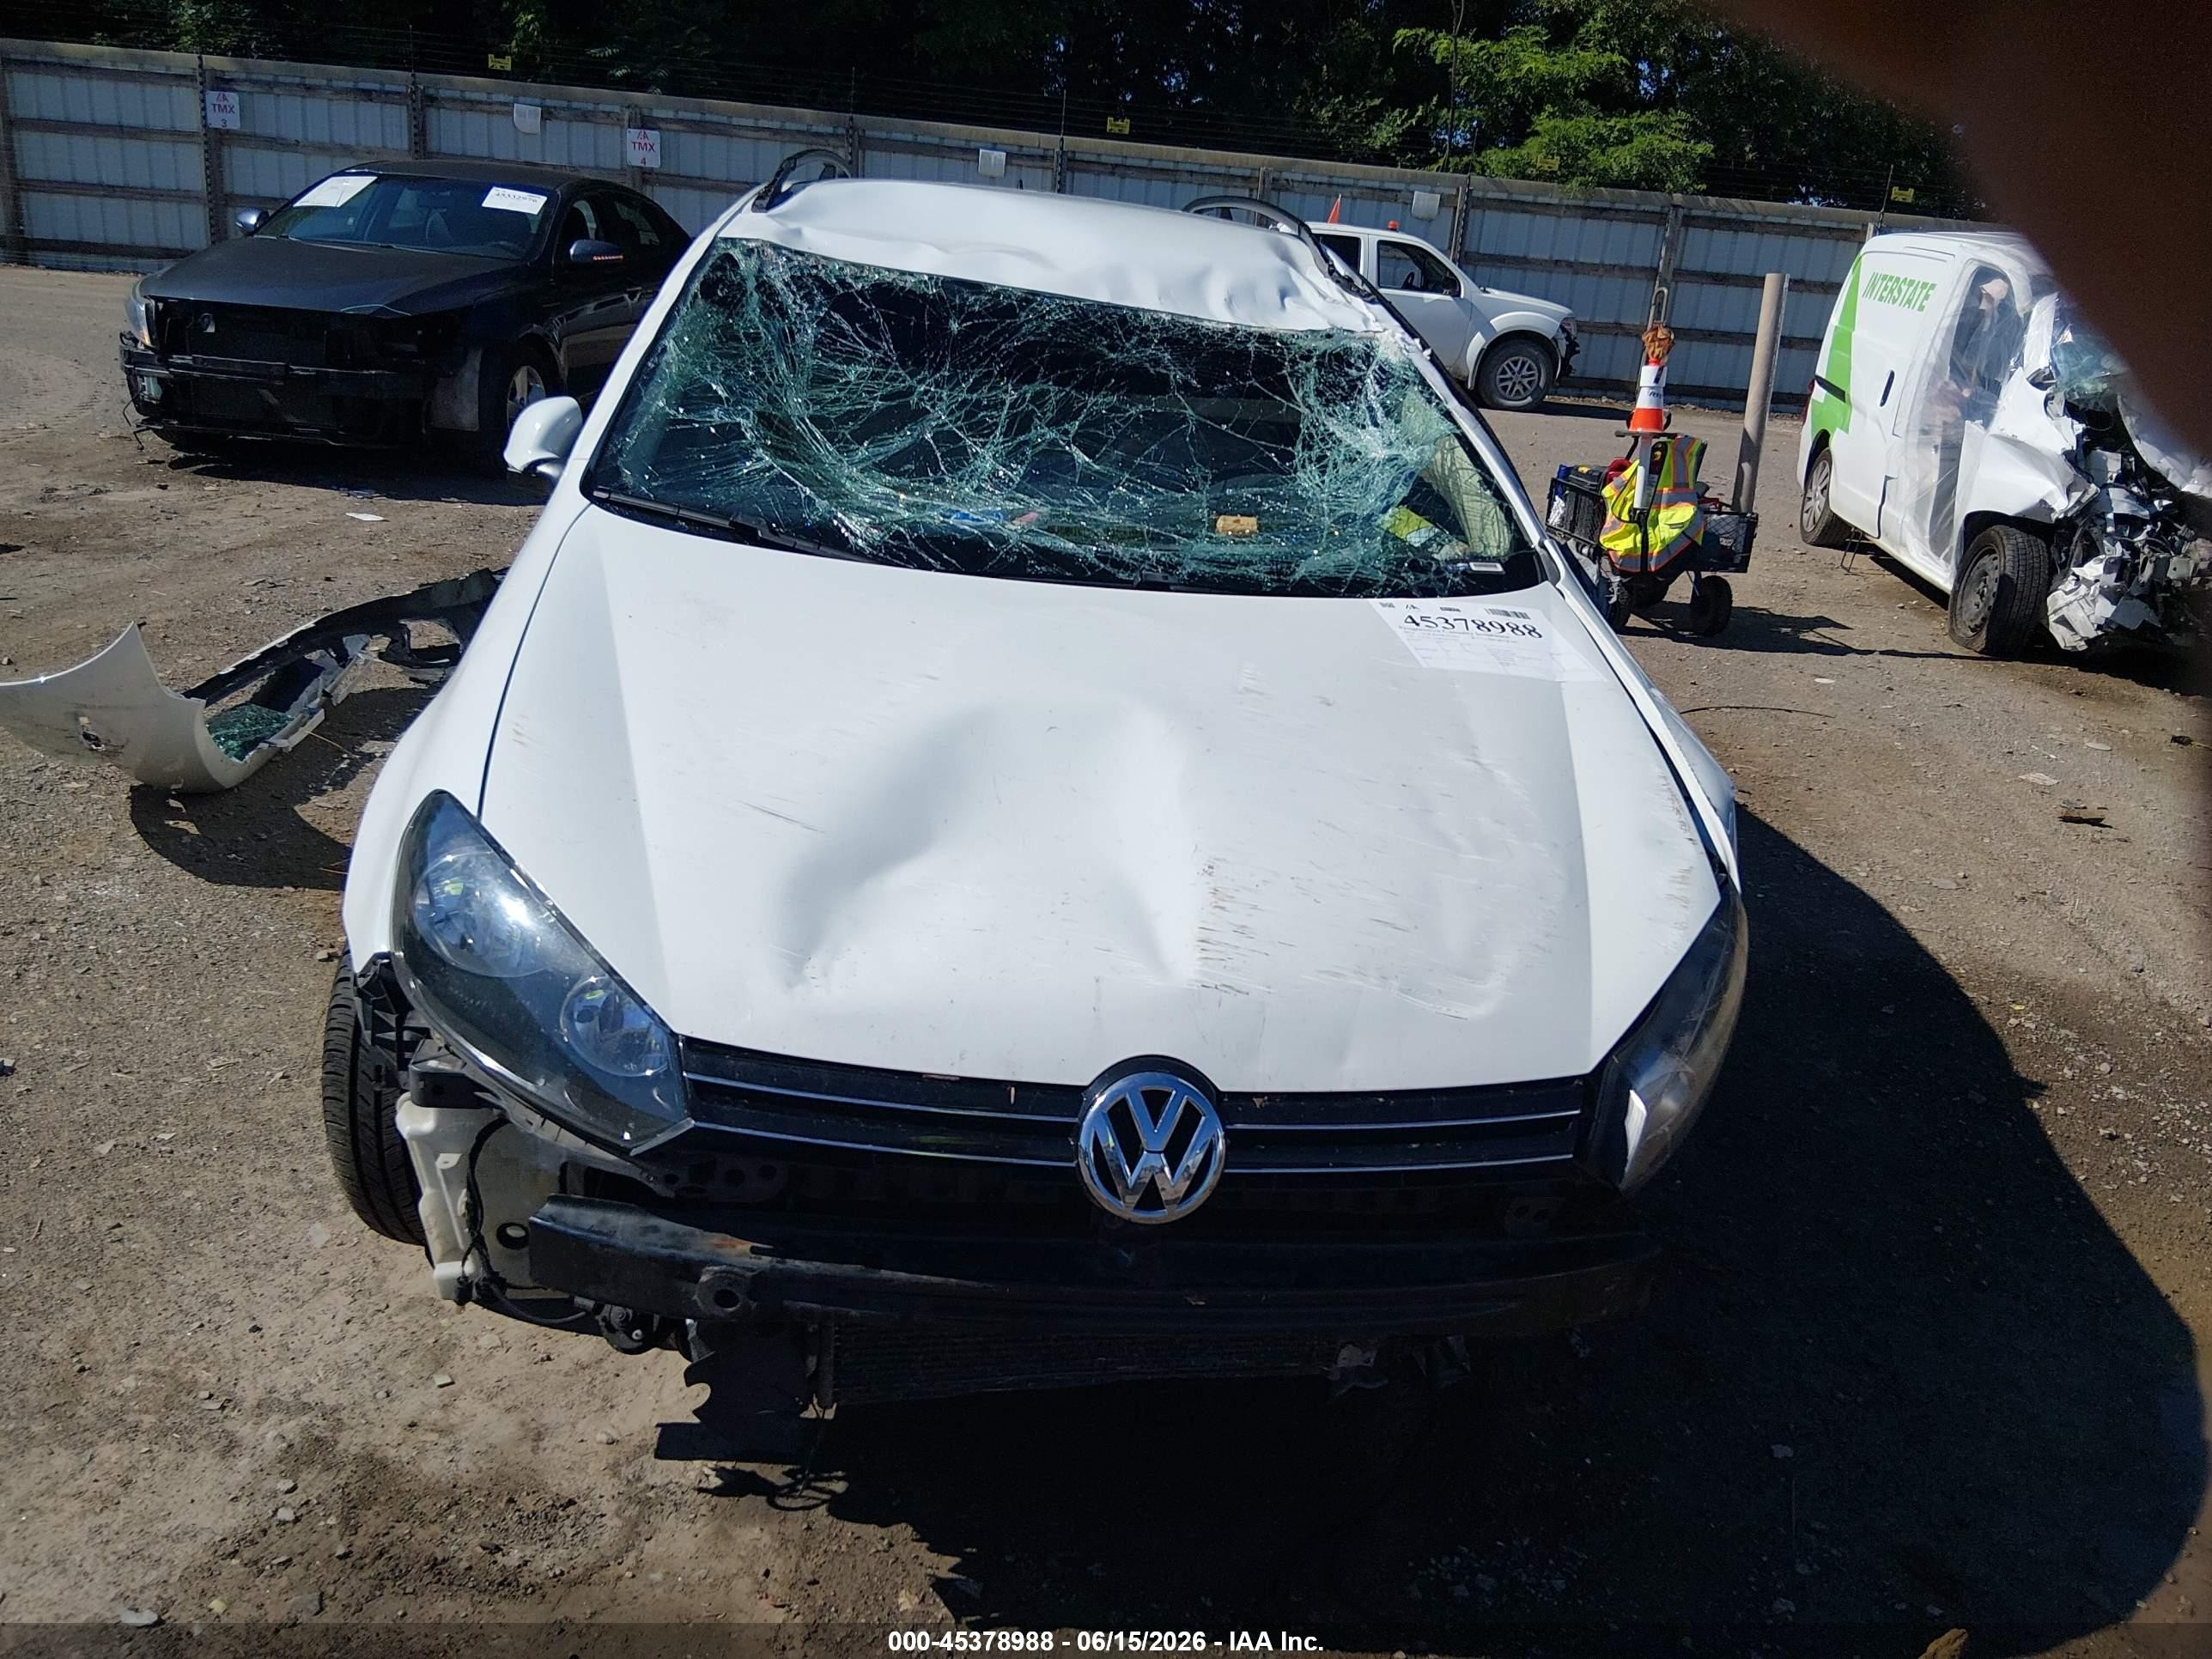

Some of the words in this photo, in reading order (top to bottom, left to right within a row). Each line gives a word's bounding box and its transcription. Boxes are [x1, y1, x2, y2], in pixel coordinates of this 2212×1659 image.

[211, 103, 235, 113] TMX
[632, 142, 656, 152] TMX
[640, 157, 647, 166] 4
[1862, 271, 1937, 312] INTERSTATE
[1403, 614, 1543, 639] 45378988
[1080, 1073, 1224, 1223] VW
